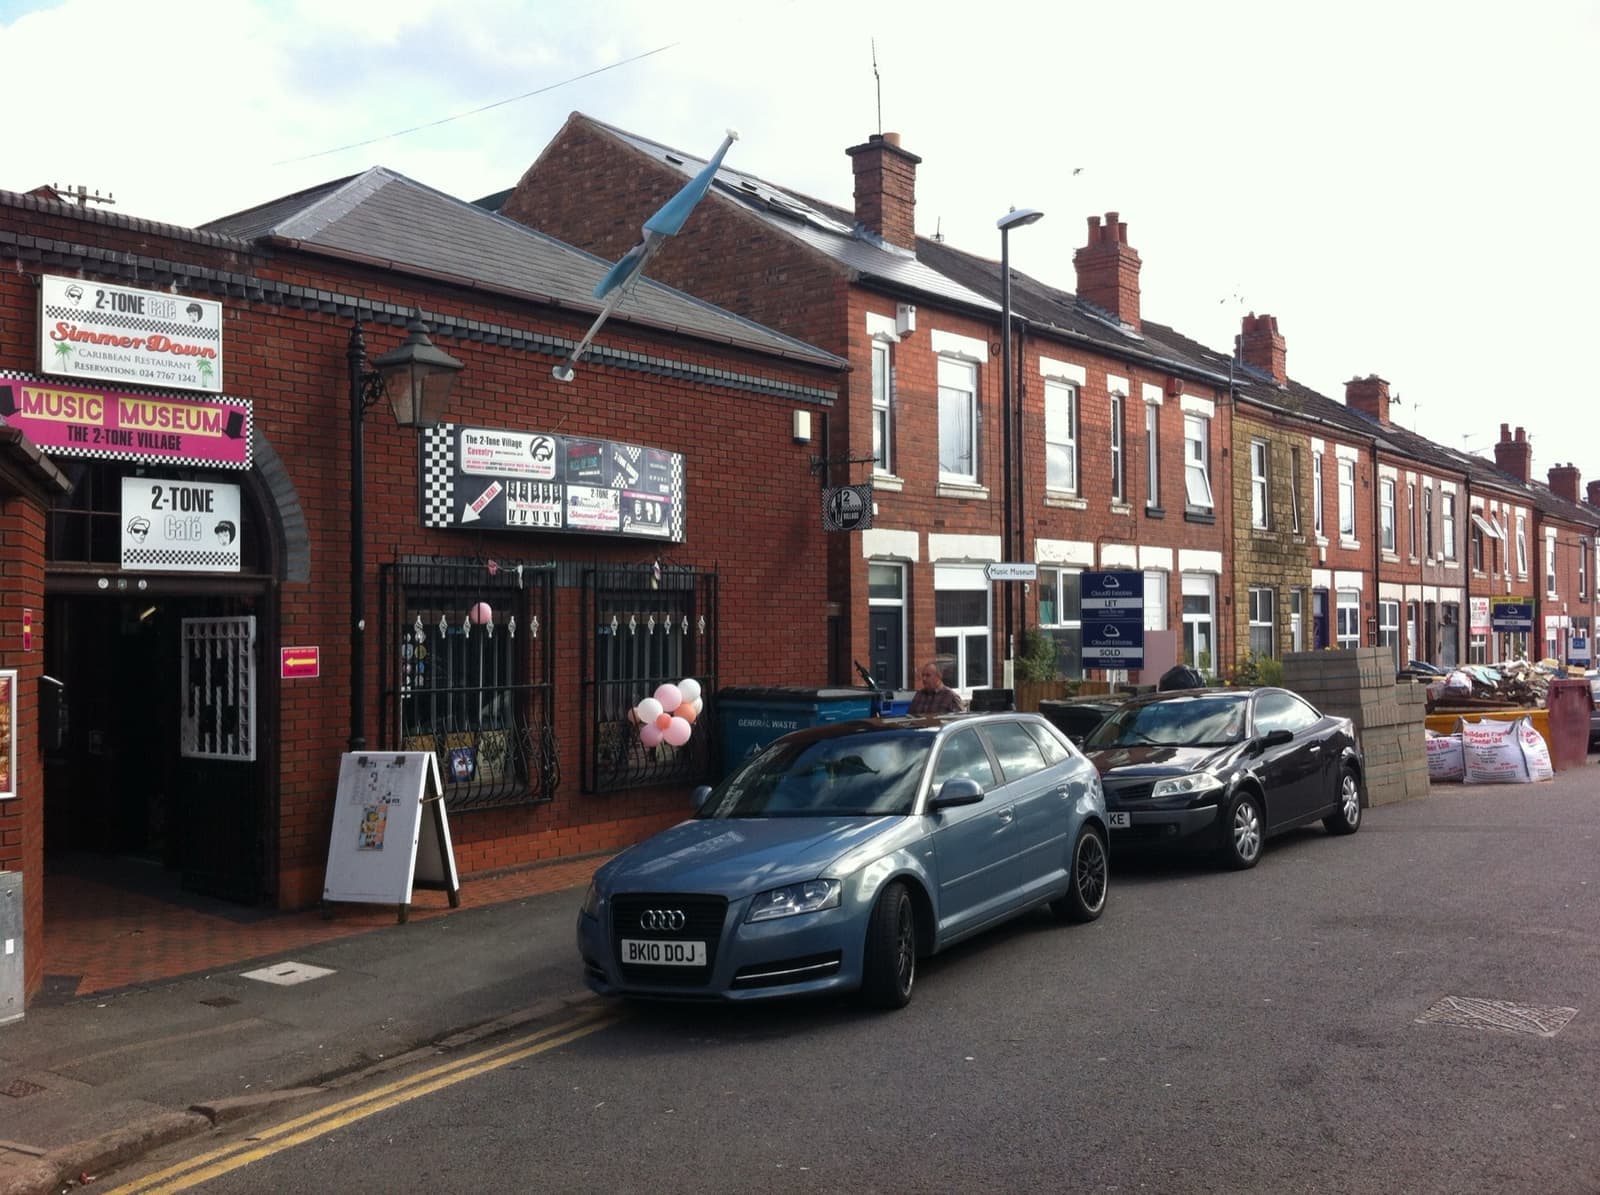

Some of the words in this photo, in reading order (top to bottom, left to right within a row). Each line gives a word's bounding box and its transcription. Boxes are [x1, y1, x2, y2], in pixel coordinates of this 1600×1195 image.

[95, 290, 145, 316] 2-TONE
[50, 321, 147, 350] Simmer
[145, 334, 218, 359] Down
[134, 355, 193, 370] RESTAURANT
[138, 369, 155, 379] 024
[156, 371, 176, 381] 7767
[22, 391, 103, 420] MUSIC
[119, 402, 221, 433] MUSEUM
[67, 425, 89, 443] THE
[92, 429, 134, 447] 2-TONE
[137, 433, 182, 451] VILLAGE
[466, 434, 478, 445] The
[479, 436, 501, 447] 2-Tone
[501, 438, 523, 449] Village
[151, 485, 215, 513] 2-TONE
[991, 567, 1009, 576] Music
[1010, 567, 1035, 576] Museum
[1099, 649, 1120, 657] SOLD
[772, 720, 798, 730] WASTE
[629, 942, 660, 961] BK10
[664, 944, 695, 963] DOJ
